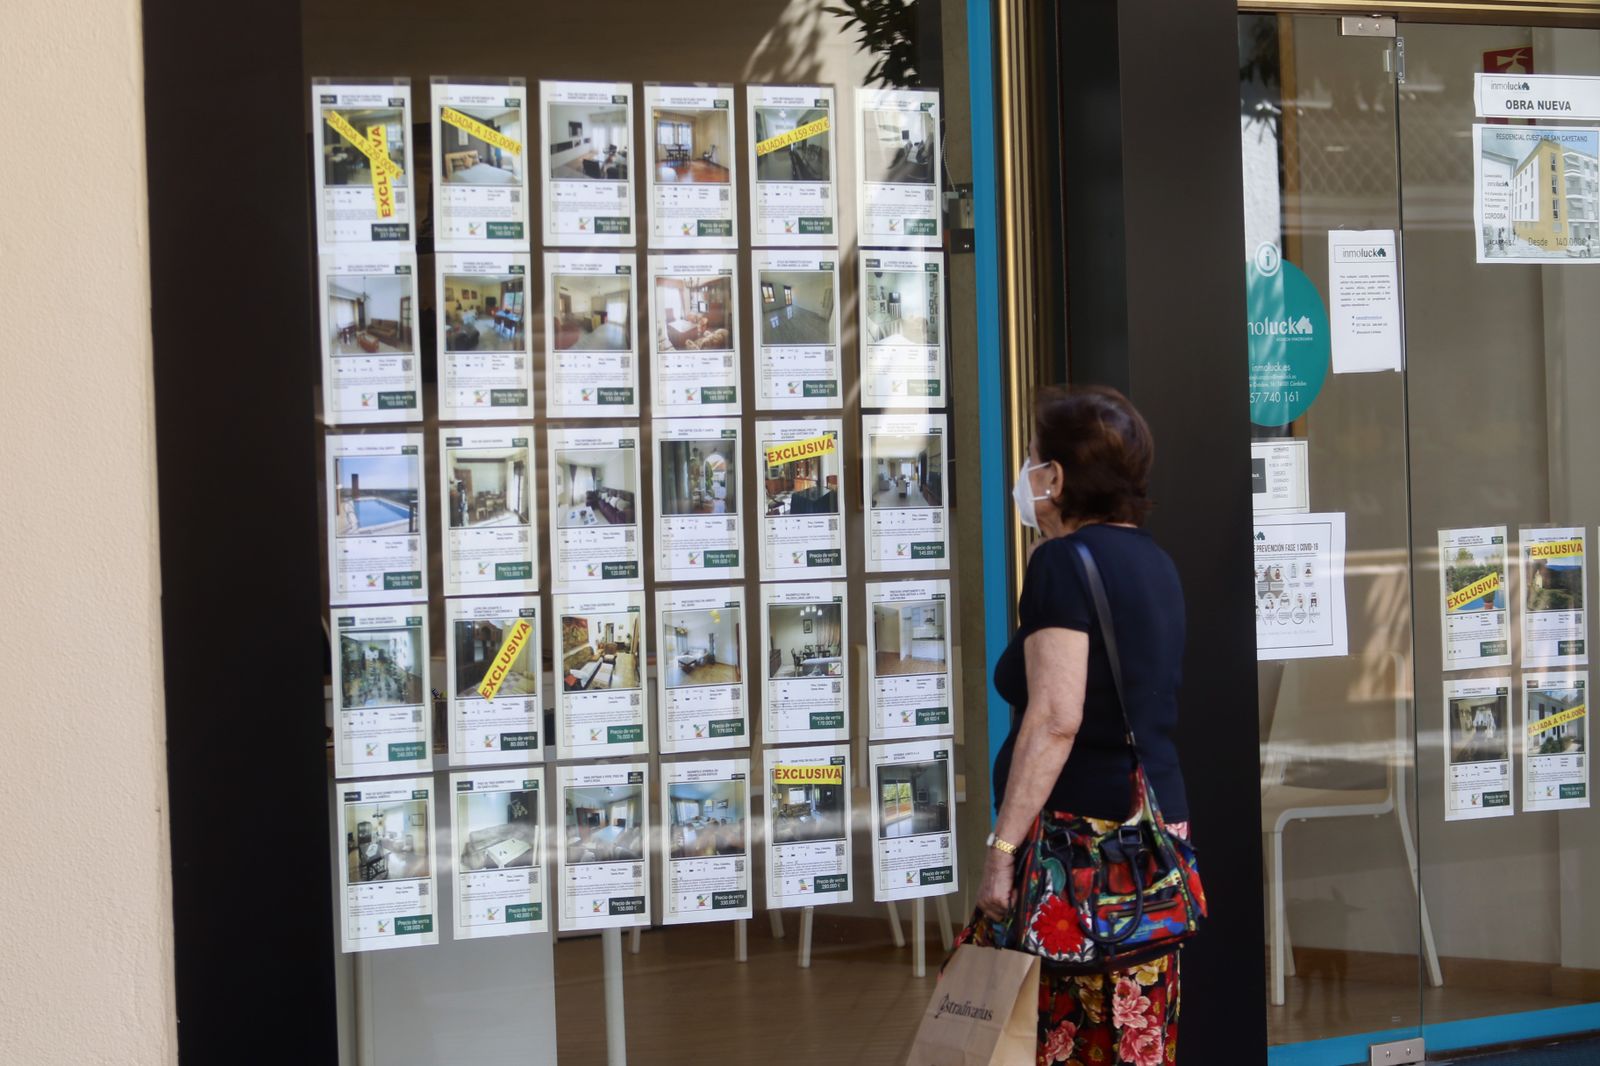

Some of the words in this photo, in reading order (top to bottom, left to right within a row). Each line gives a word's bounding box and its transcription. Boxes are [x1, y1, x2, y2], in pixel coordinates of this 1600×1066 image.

[1491, 80, 1522, 90] inmoluck
[1506, 100, 1534, 110] OBRA
[1537, 100, 1571, 111] NUEVA
[443, 108, 474, 130] BAJADA
[1496, 133, 1525, 141] RESIDENCIAL
[757, 137, 784, 153] BAJADA
[1528, 237, 1548, 246] Desde
[1342, 248, 1377, 258] inmoluck
[1263, 392, 1280, 402] 740
[1284, 392, 1299, 402] 161
[768, 438, 834, 463] EXCLUSIVA
[1256, 544, 1284, 552] PREVENCIÓN
[1285, 544, 1296, 552] FASE
[1531, 543, 1583, 556] EXCLUSIVA
[1446, 576, 1499, 609] EXCLUSIVA
[482, 622, 530, 700] EXCLUSIVA
[774, 768, 842, 780] EXCLUSIVA
